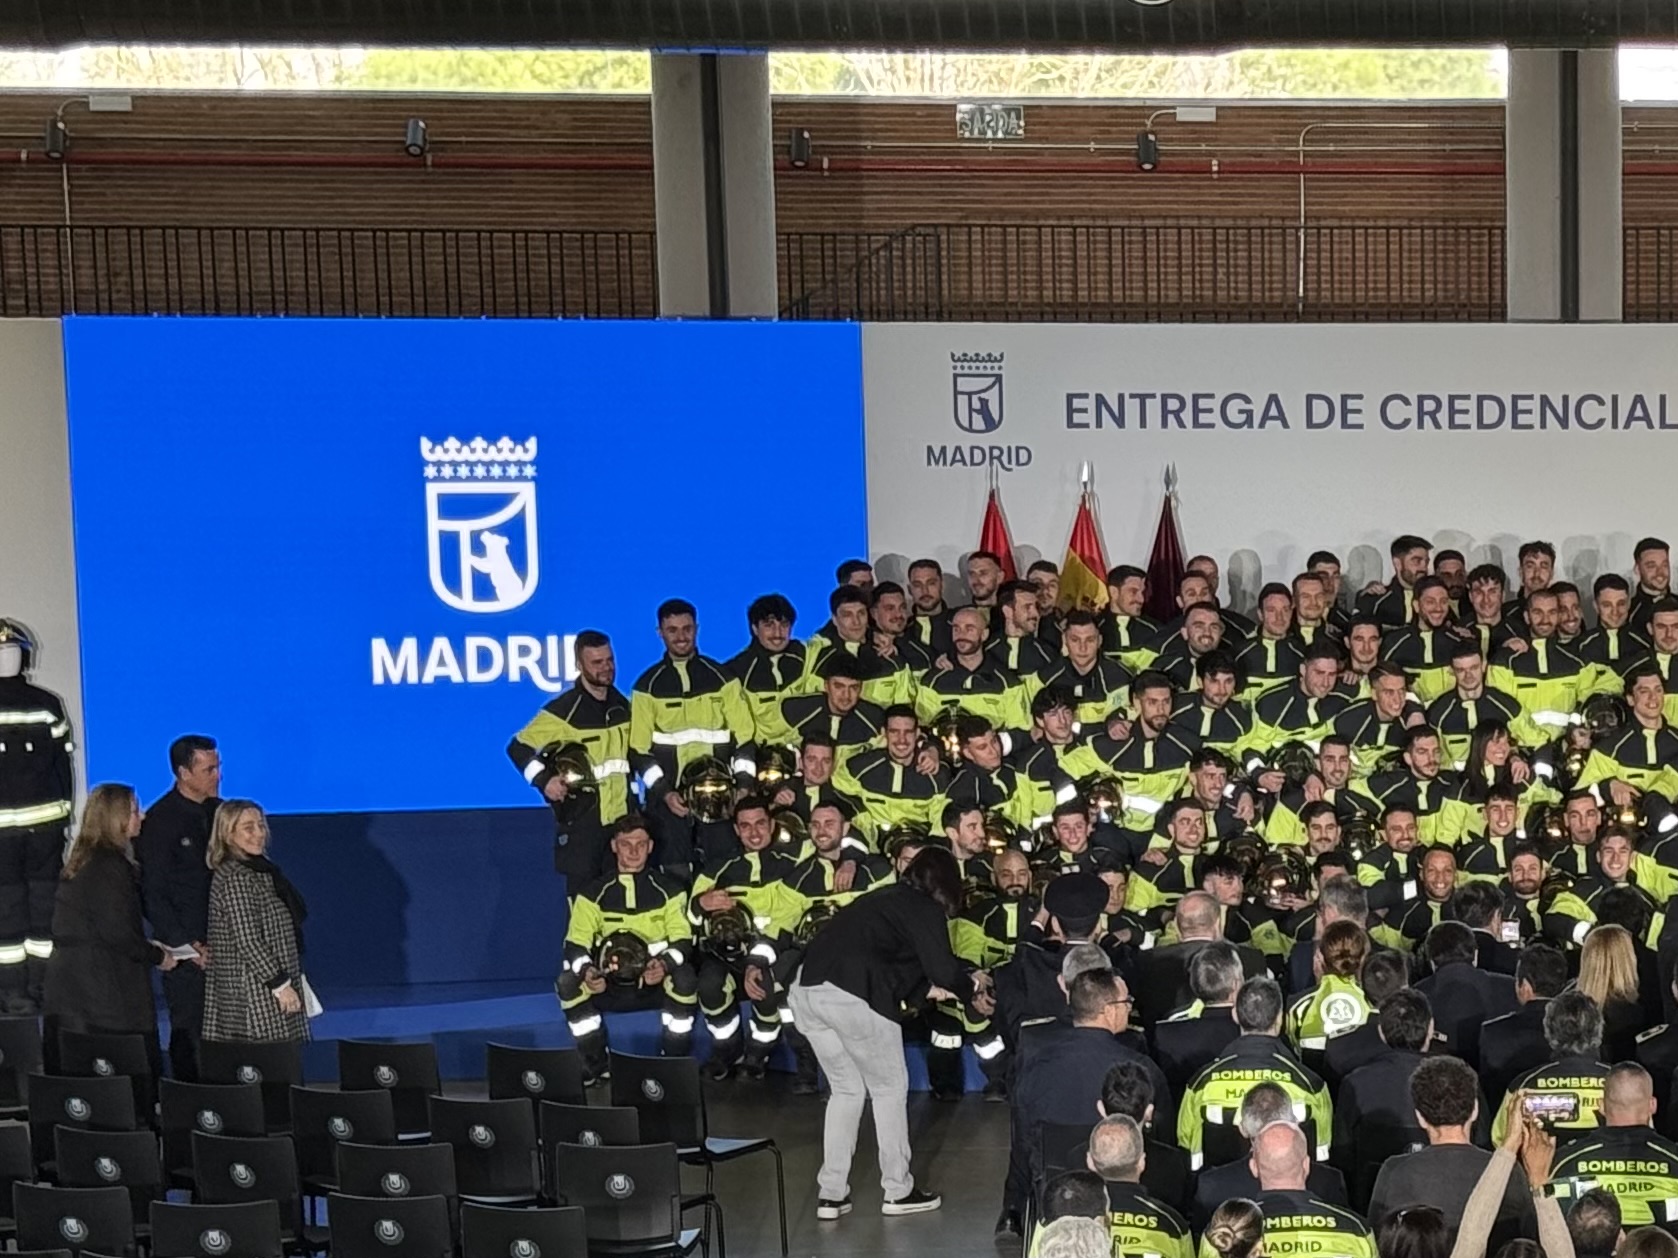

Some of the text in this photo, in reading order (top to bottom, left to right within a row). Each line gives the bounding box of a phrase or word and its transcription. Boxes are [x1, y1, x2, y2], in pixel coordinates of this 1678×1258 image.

[1065, 392, 1290, 430] ENTREGA
[1305, 393, 1365, 430] DE
[926, 445, 1033, 472] MADRID
[1211, 1069, 1291, 1081] BOMBEROS
[1577, 1160, 1669, 1174] BOMBEROS
[1601, 1181, 1656, 1194] ADRID
[1113, 1212, 1158, 1228] EROS
[1263, 1215, 1337, 1229] MBEROS
